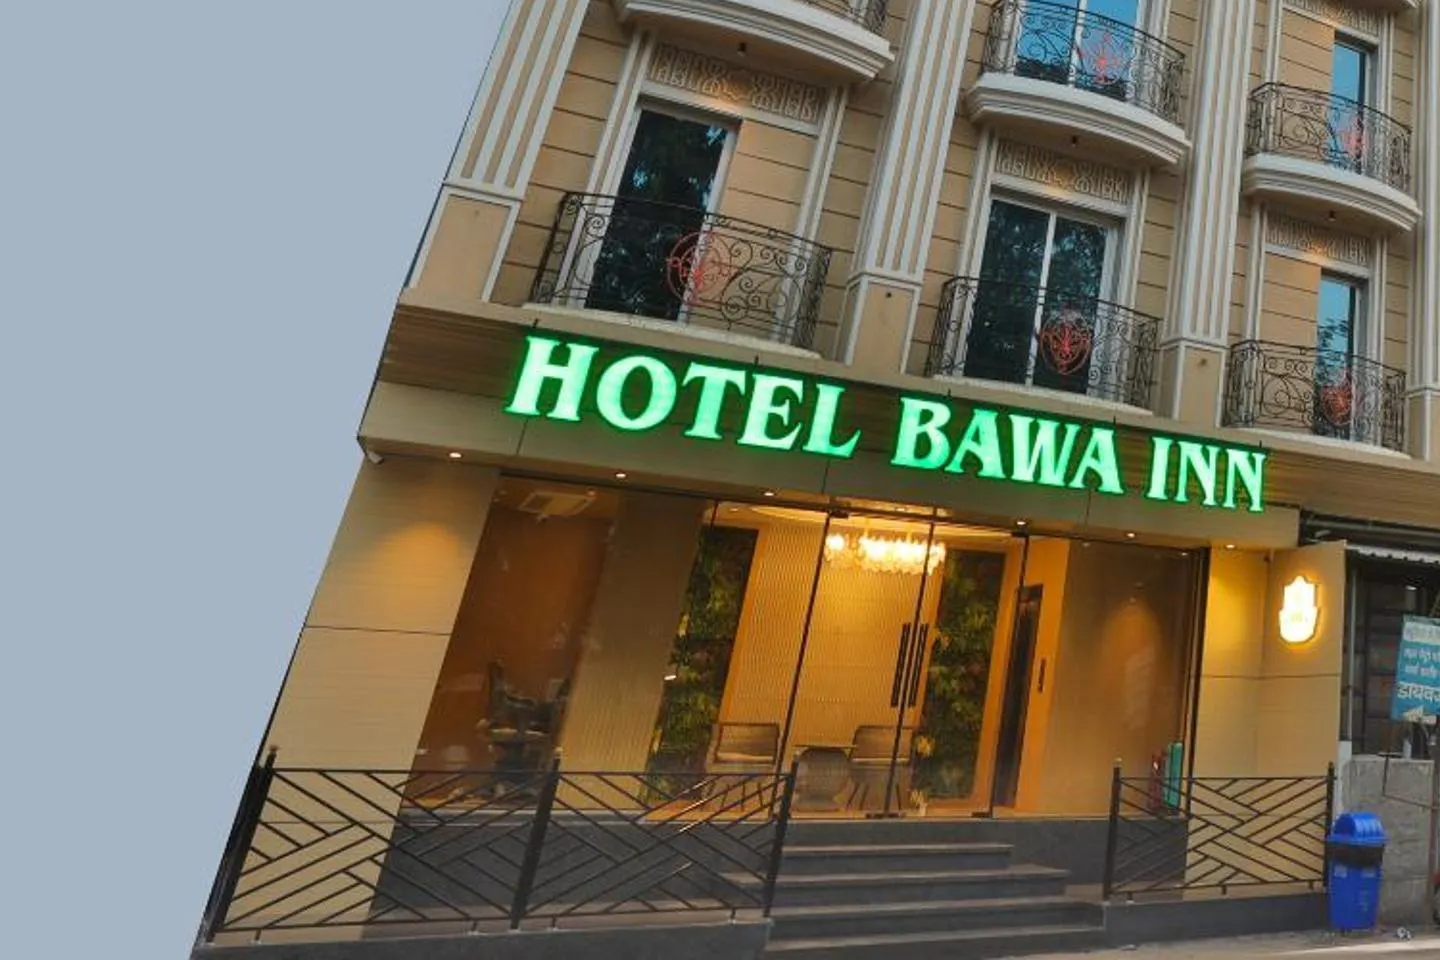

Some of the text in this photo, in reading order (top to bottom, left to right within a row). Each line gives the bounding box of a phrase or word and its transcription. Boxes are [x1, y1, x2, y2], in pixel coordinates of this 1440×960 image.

[505, 336, 1268, 512] HOTEL BAWA INN
